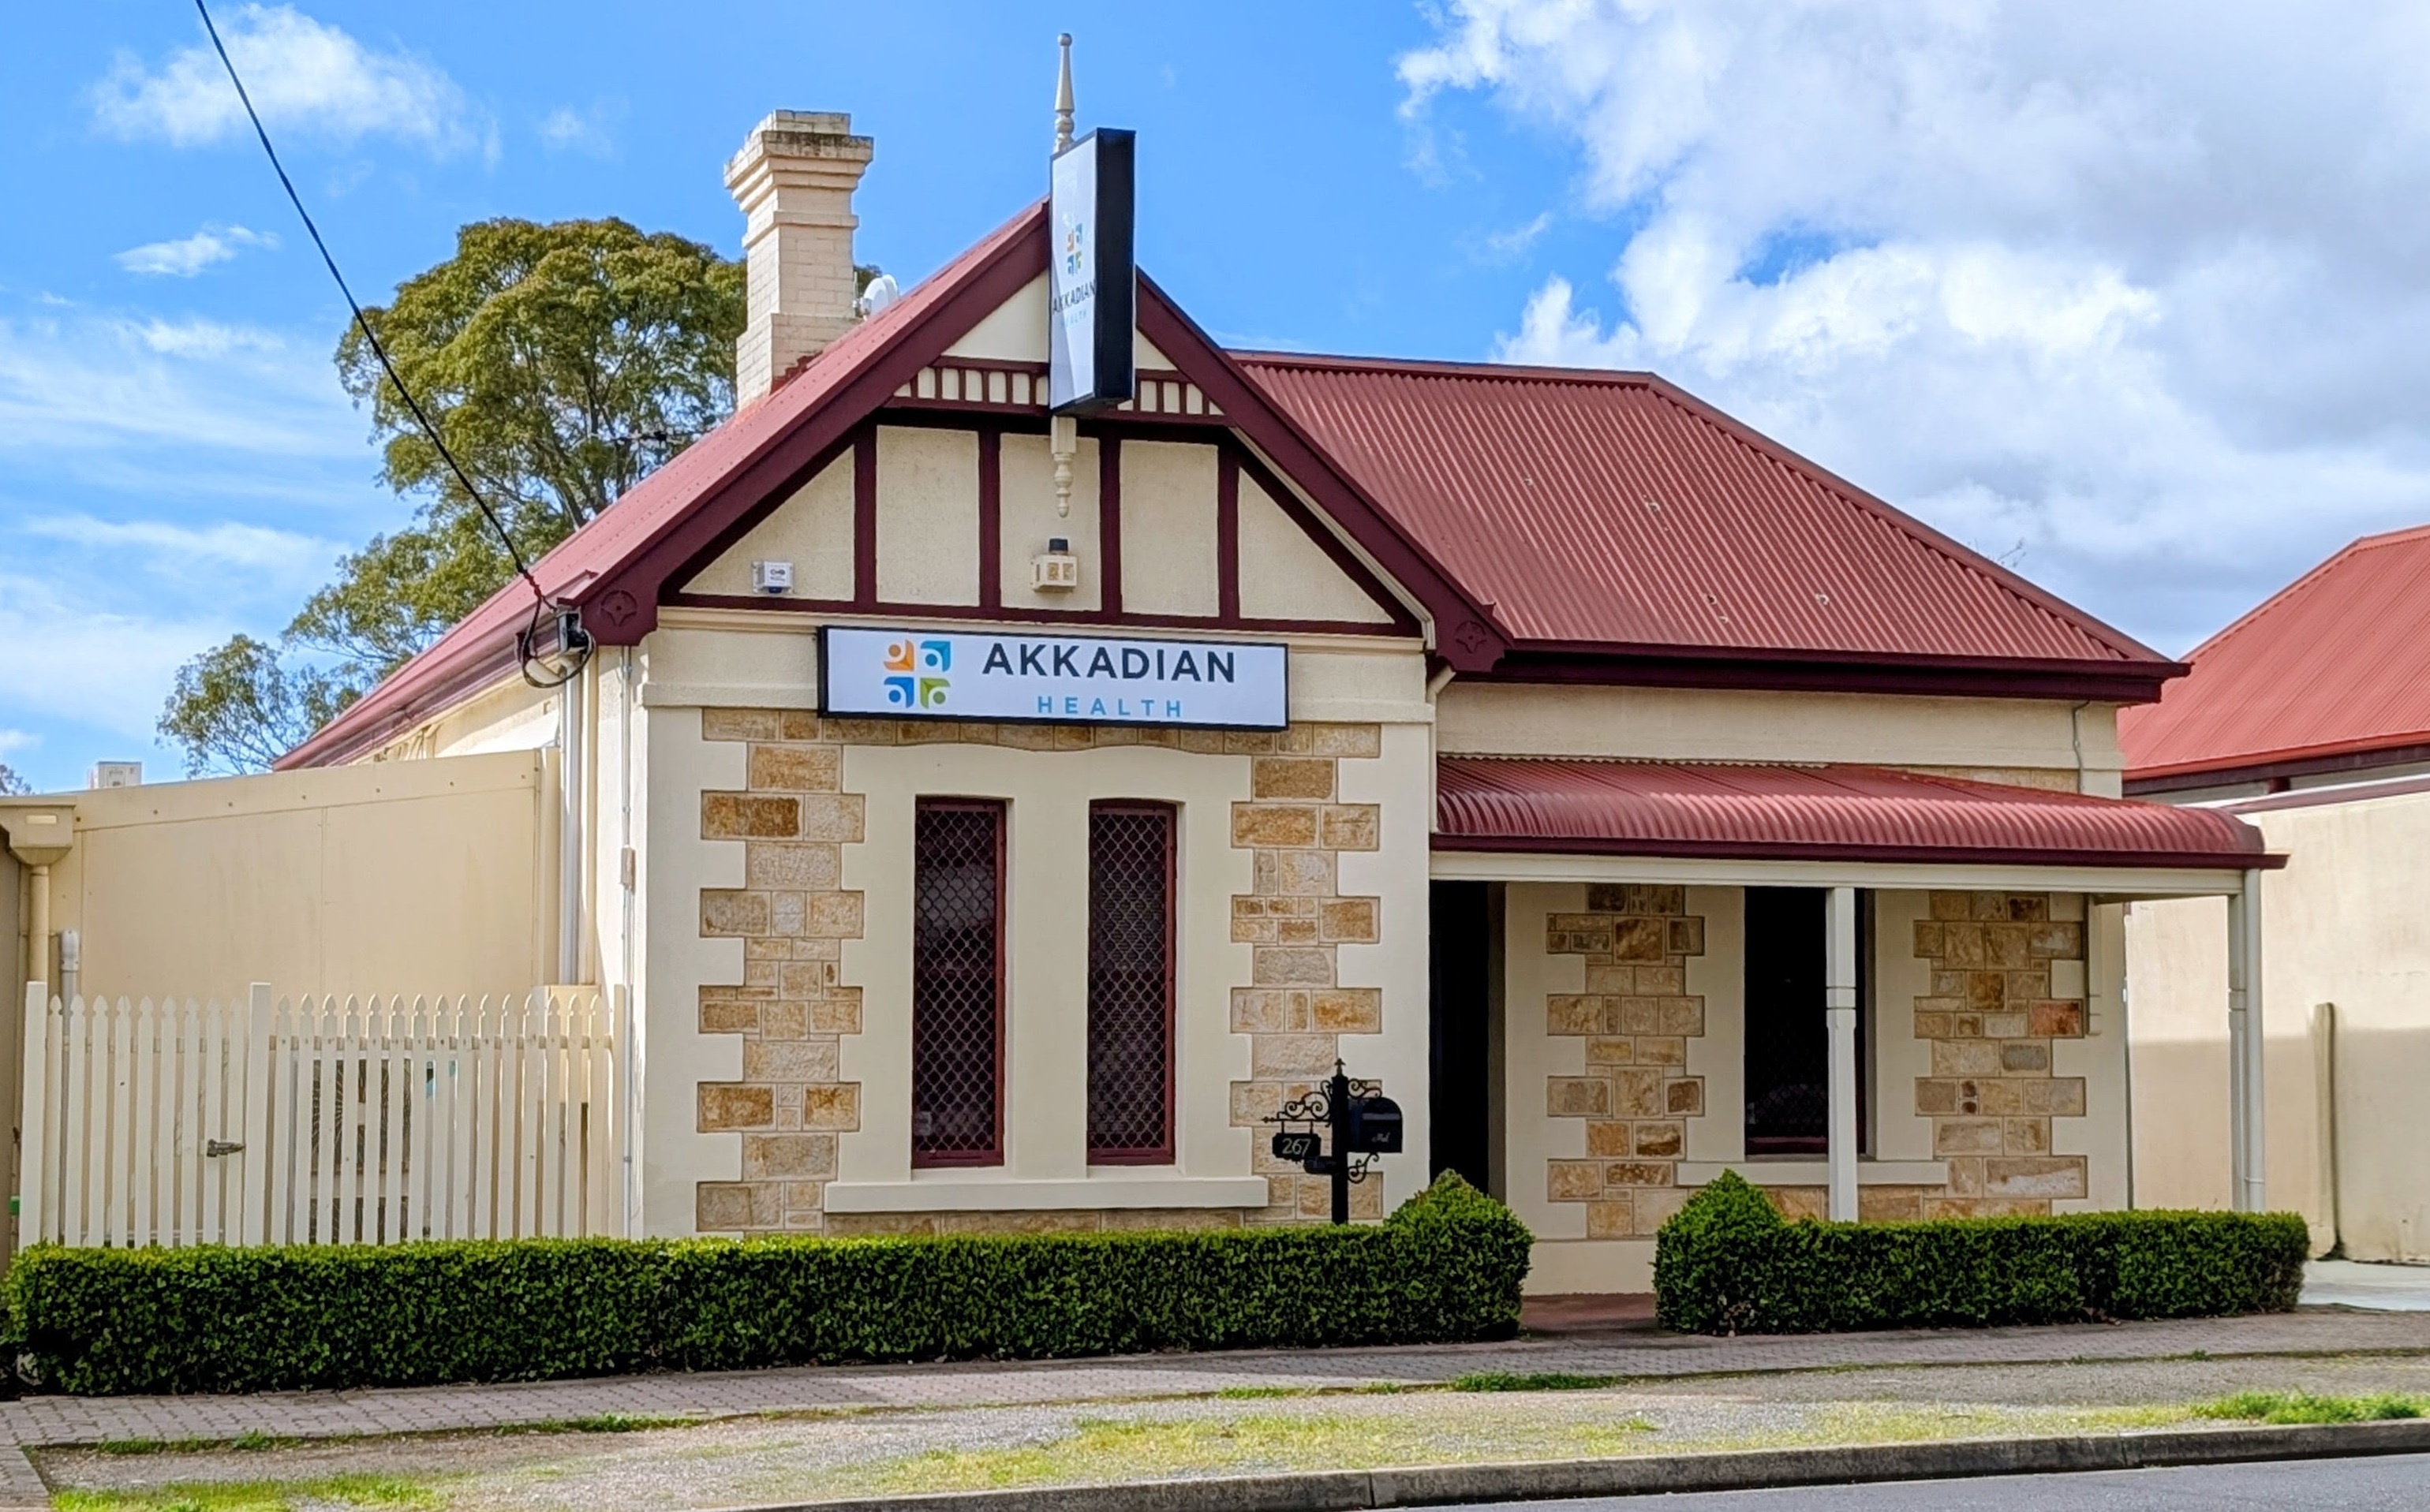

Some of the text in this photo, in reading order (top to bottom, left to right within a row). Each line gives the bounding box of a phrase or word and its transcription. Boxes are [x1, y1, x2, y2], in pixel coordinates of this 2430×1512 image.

[982, 643, 1235, 683] AKKADIAN
[1037, 696, 1182, 717] HEALTH
[1282, 1138, 1311, 1155] 267
